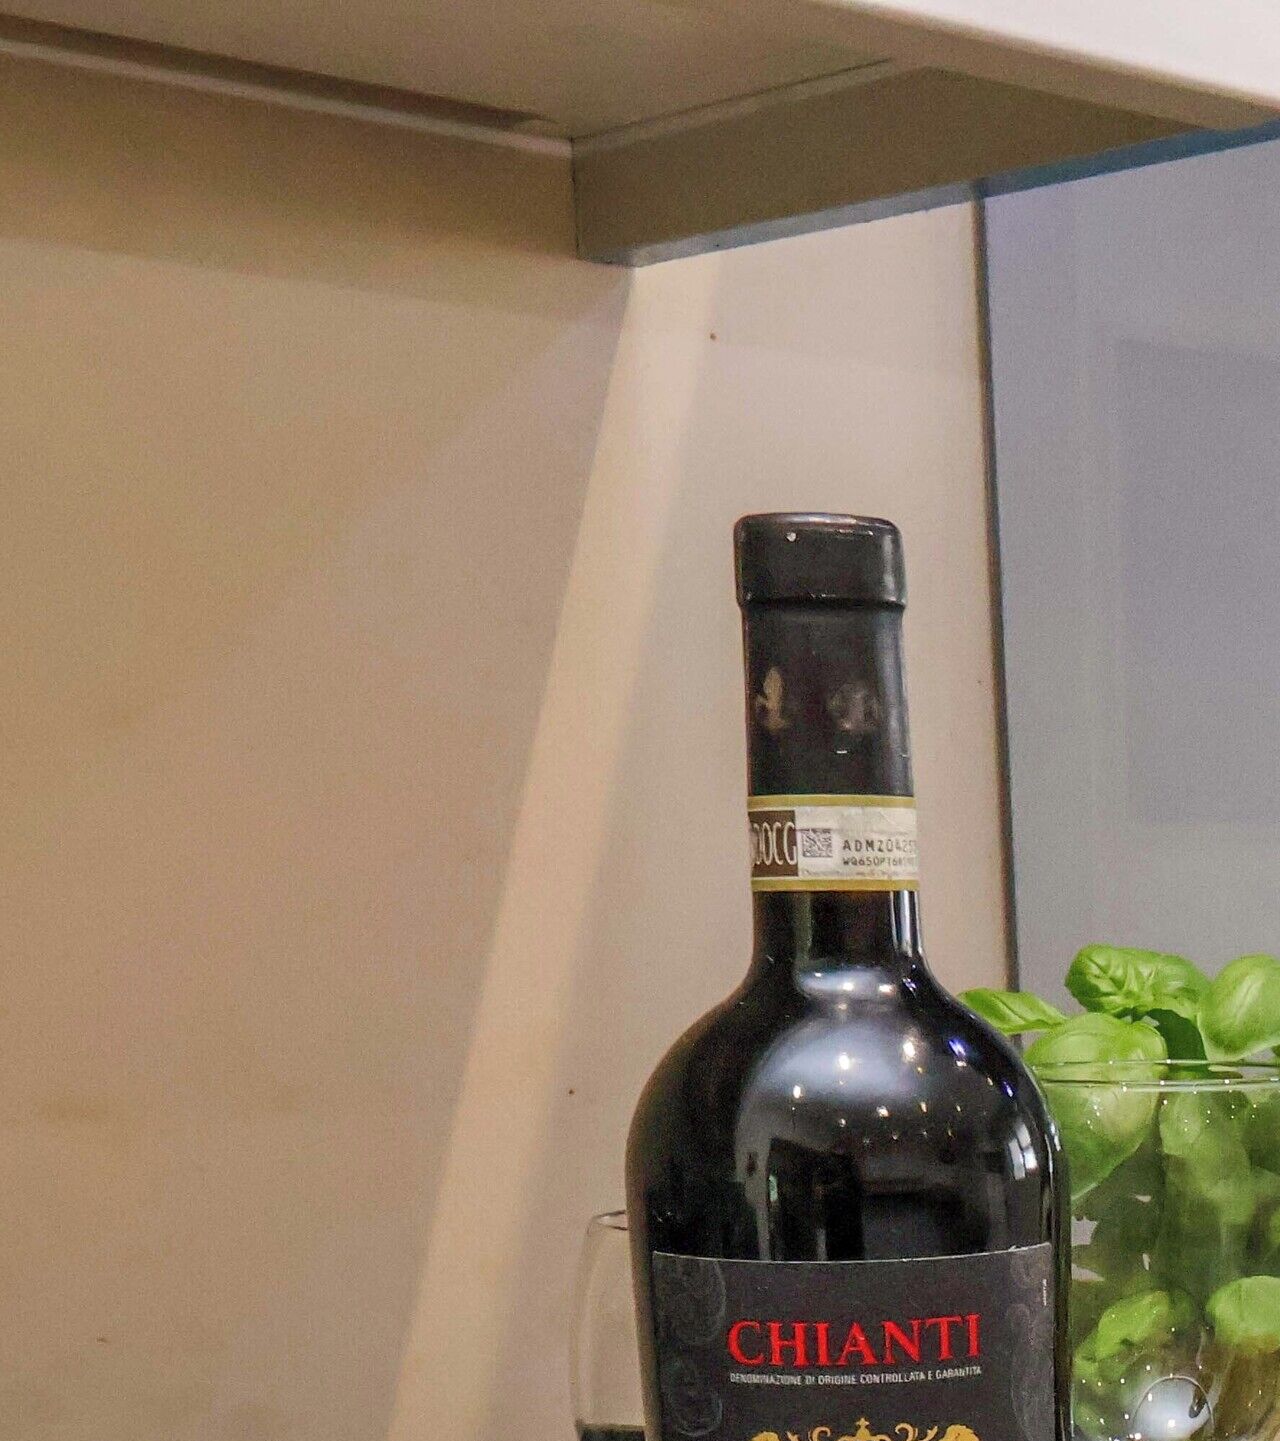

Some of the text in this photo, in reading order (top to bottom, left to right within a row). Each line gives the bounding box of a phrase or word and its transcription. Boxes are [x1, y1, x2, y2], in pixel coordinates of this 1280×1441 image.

[726, 1312, 982, 1368] CHIANTI
[730, 1373, 802, 1385] DENOMINAZIONE
[805, 1375, 815, 1385] DI
[818, 1374, 858, 1385] ORIGINE
[860, 1371, 926, 1385] CONTROLLATA
[935, 1365, 982, 1380] GARANTITA
